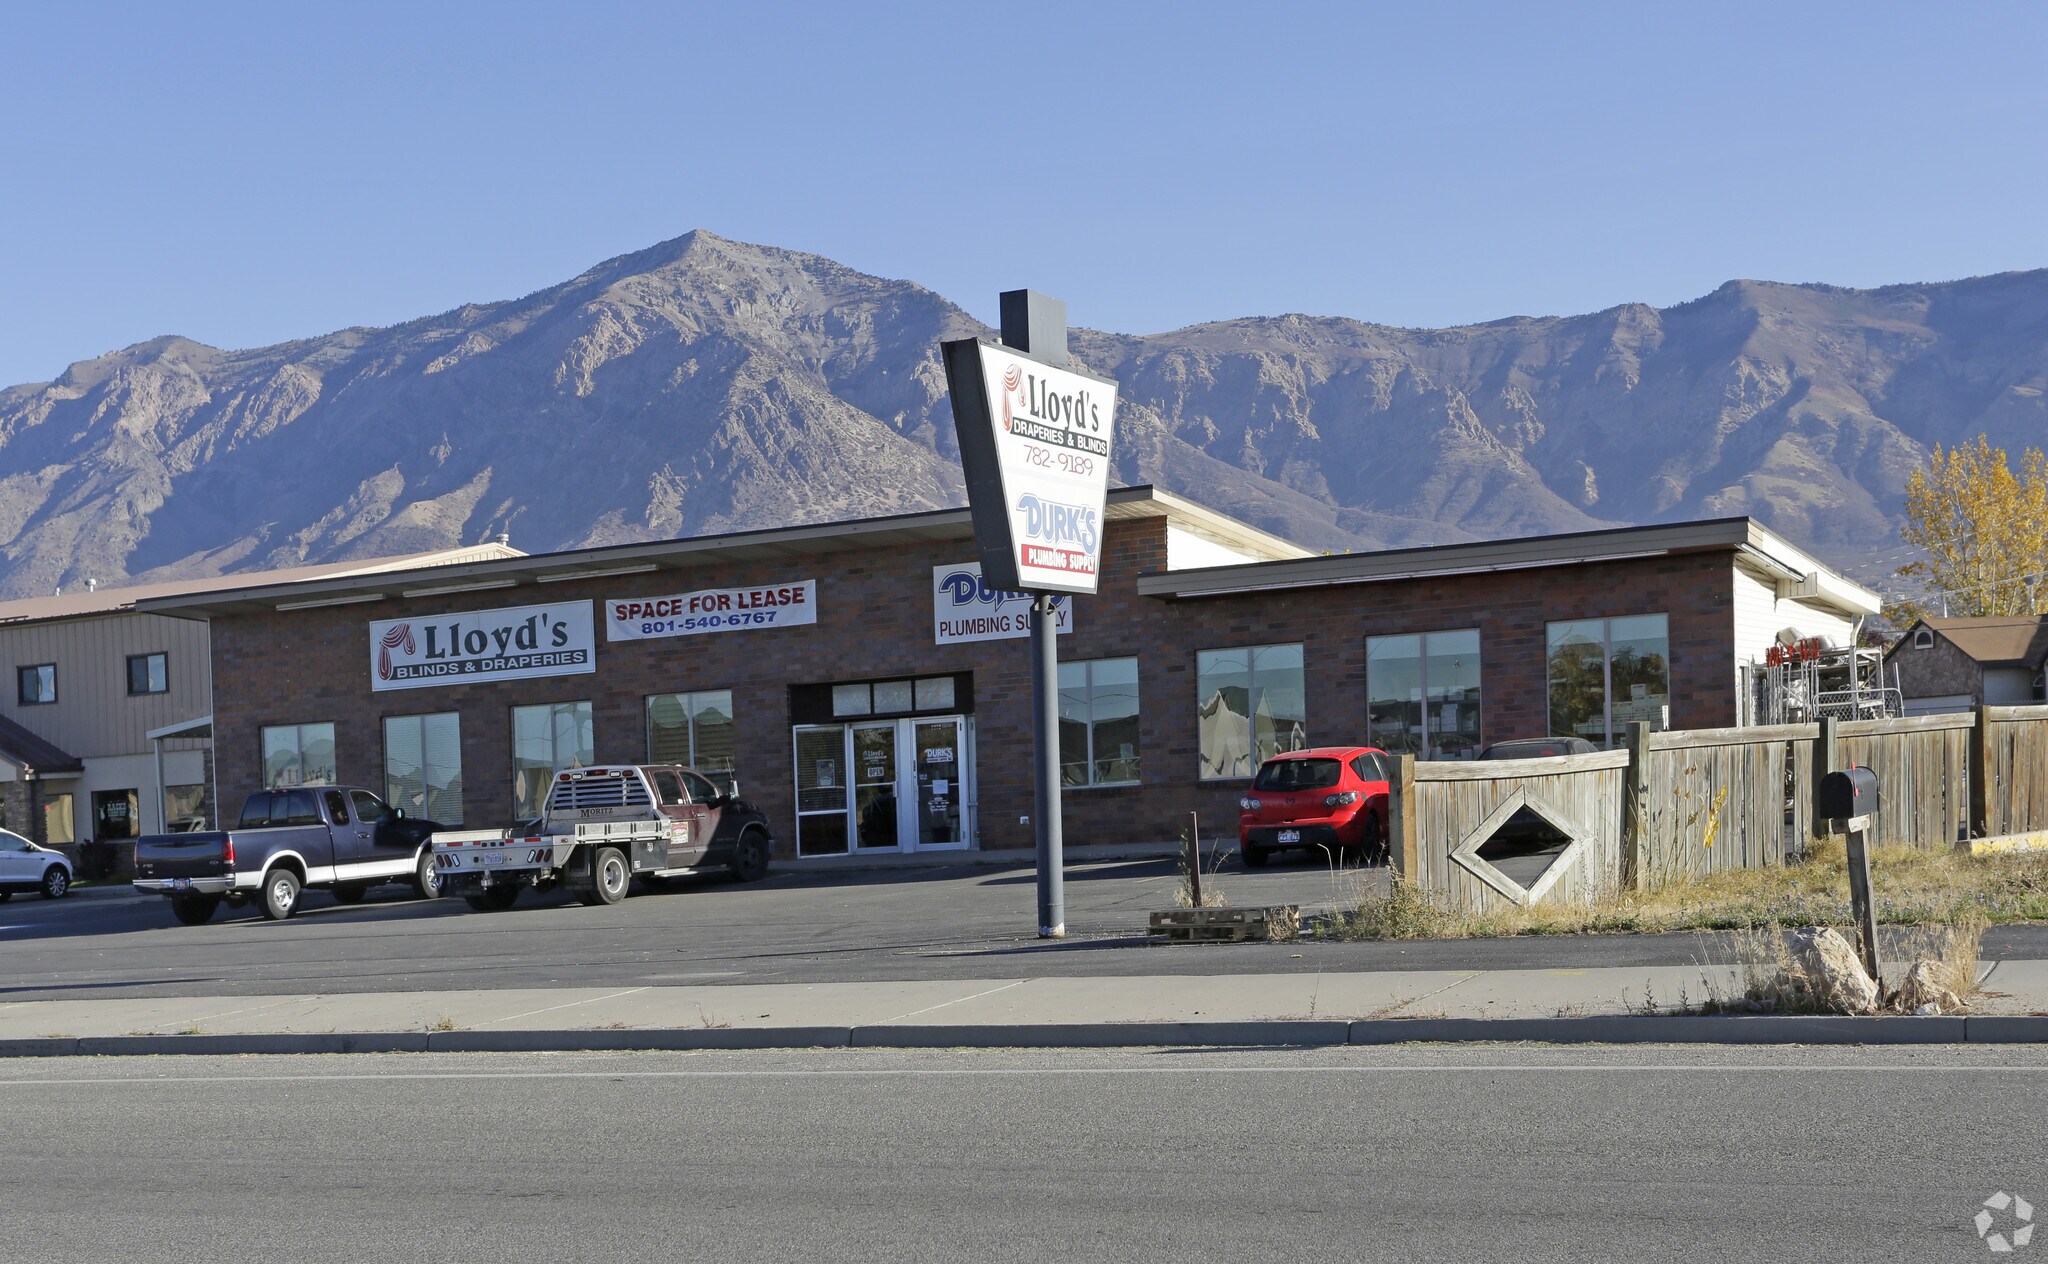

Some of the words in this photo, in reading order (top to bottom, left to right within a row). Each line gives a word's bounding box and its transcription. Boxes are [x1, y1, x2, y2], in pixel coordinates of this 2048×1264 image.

[1028, 374, 1099, 433] Lloyd's
[1013, 419, 1064, 445] DRAPERIES
[1067, 433, 1075, 447] &
[1077, 436, 1107, 455] BLINDS
[1023, 444, 1093, 476] 782-9189
[1016, 493, 1097, 557] DURK'S
[1028, 548, 1067, 568] PLUMBING
[1069, 554, 1095, 572] SUPPLY
[615, 599, 683, 621] SPACE
[689, 594, 731, 614] FOR
[738, 587, 805, 610] LEASE
[424, 612, 568, 659] Lloyd's
[641, 611, 777, 634] 801-540-6767
[940, 615, 1010, 637] PLUMBING
[396, 662, 459, 679] BLINDS
[464, 661, 476, 672] &
[481, 652, 584, 671] DRAPERIES
[869, 767, 884, 777] OPEN
[580, 807, 613, 818] MORITZ
